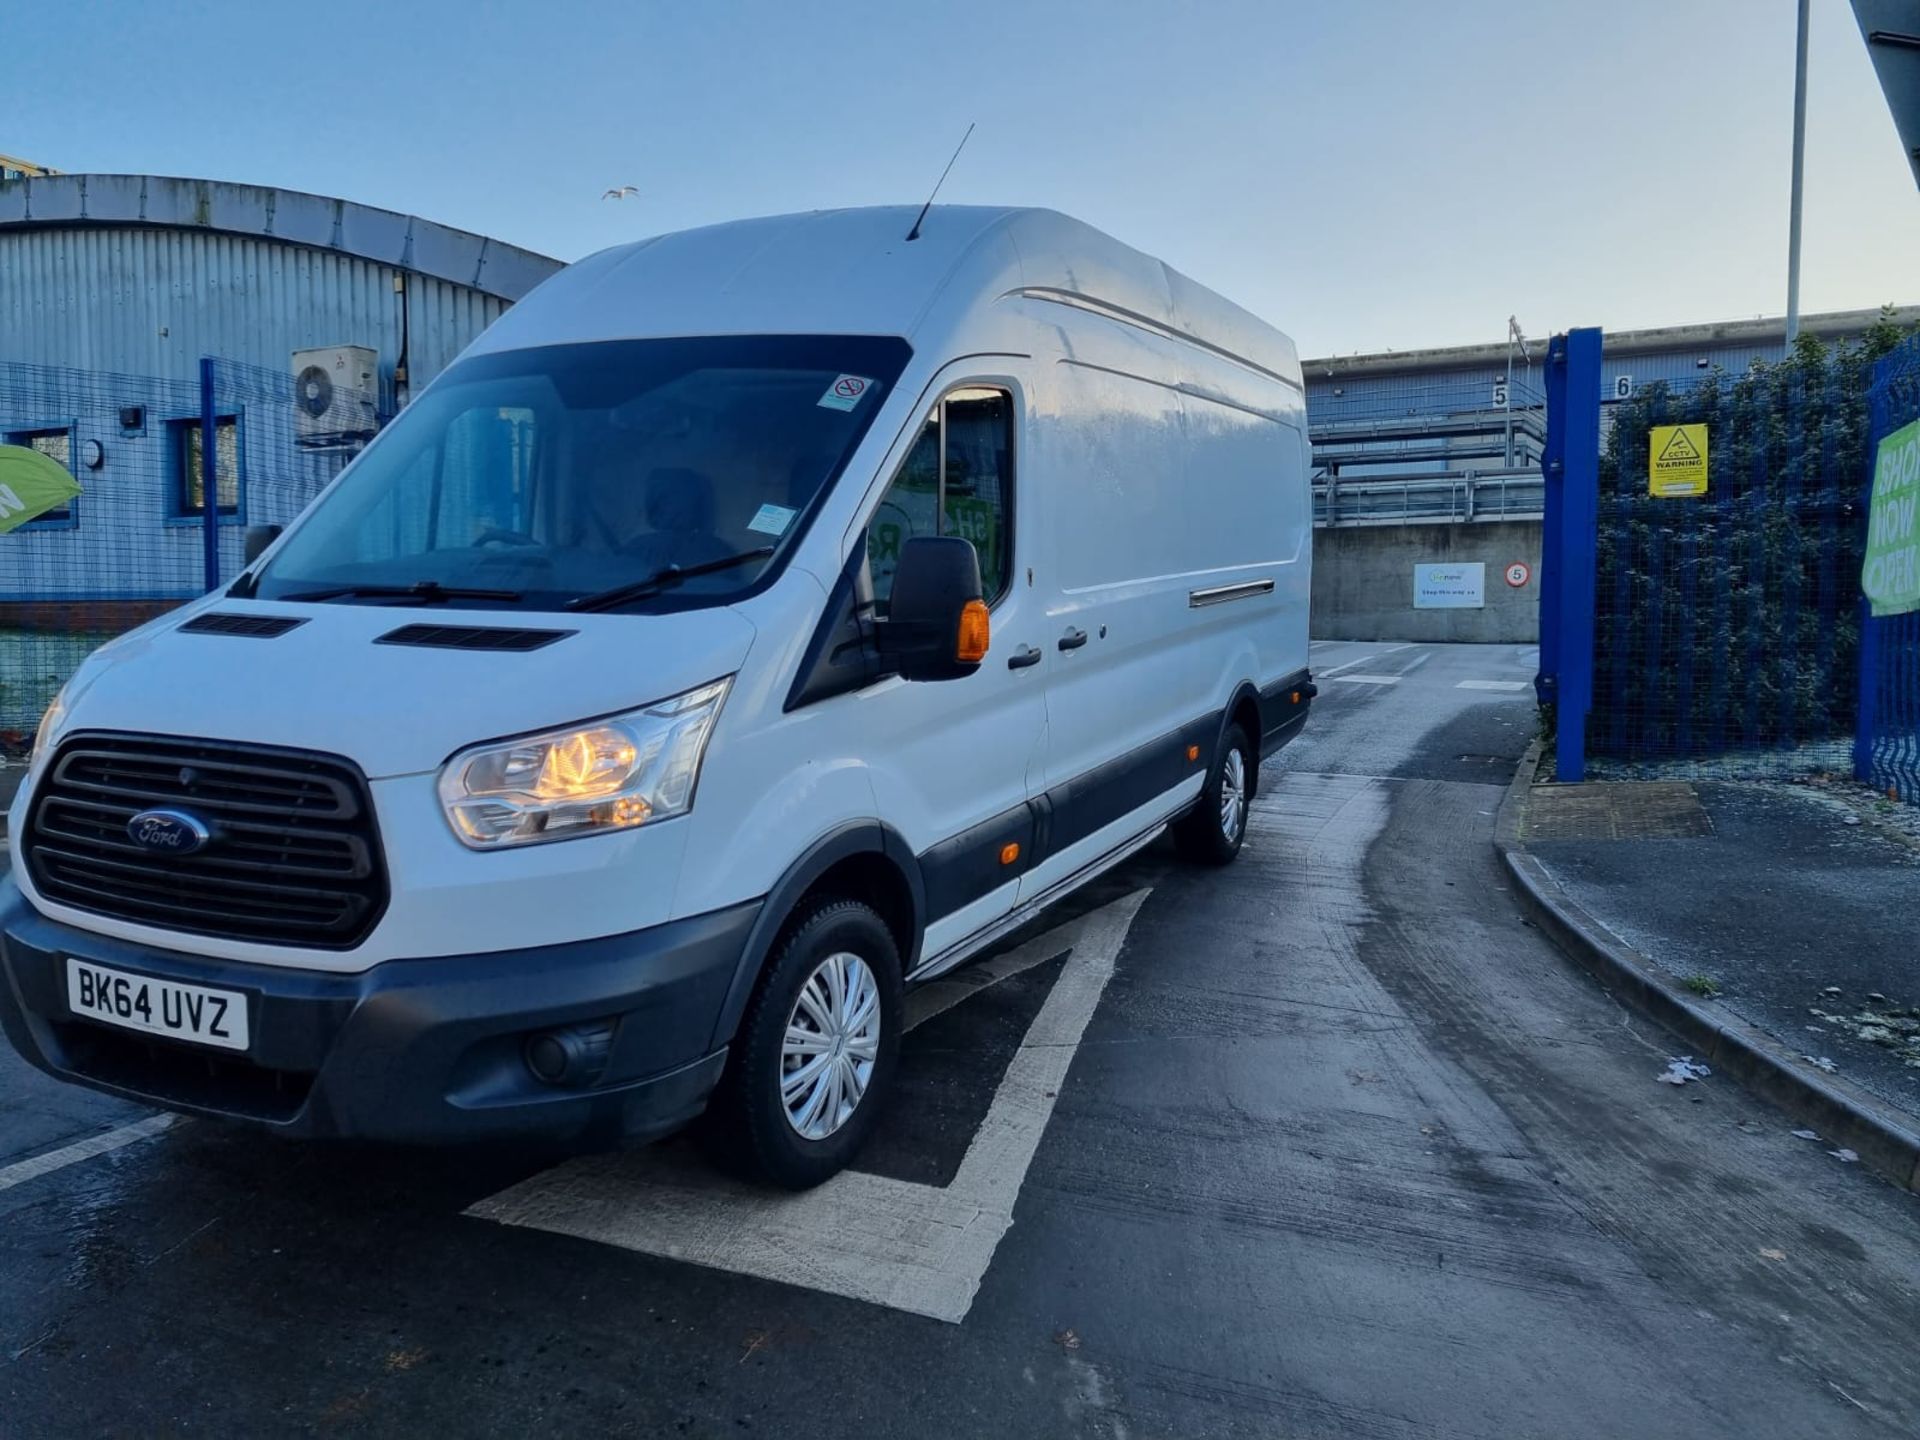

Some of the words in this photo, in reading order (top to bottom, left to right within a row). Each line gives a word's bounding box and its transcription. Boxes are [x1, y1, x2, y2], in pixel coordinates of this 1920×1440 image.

[1495, 386, 1506, 405] 5
[1617, 377, 1629, 396] 6
[1668, 450, 1691, 458] CCTV
[1655, 460, 1703, 469] WARNING
[1874, 491, 1917, 548] NOW
[1513, 568, 1522, 580] 5
[1867, 544, 1918, 598] OPEN
[139, 818, 183, 847] Ford
[78, 967, 153, 1024] BK64
[162, 988, 230, 1039] UVZ
